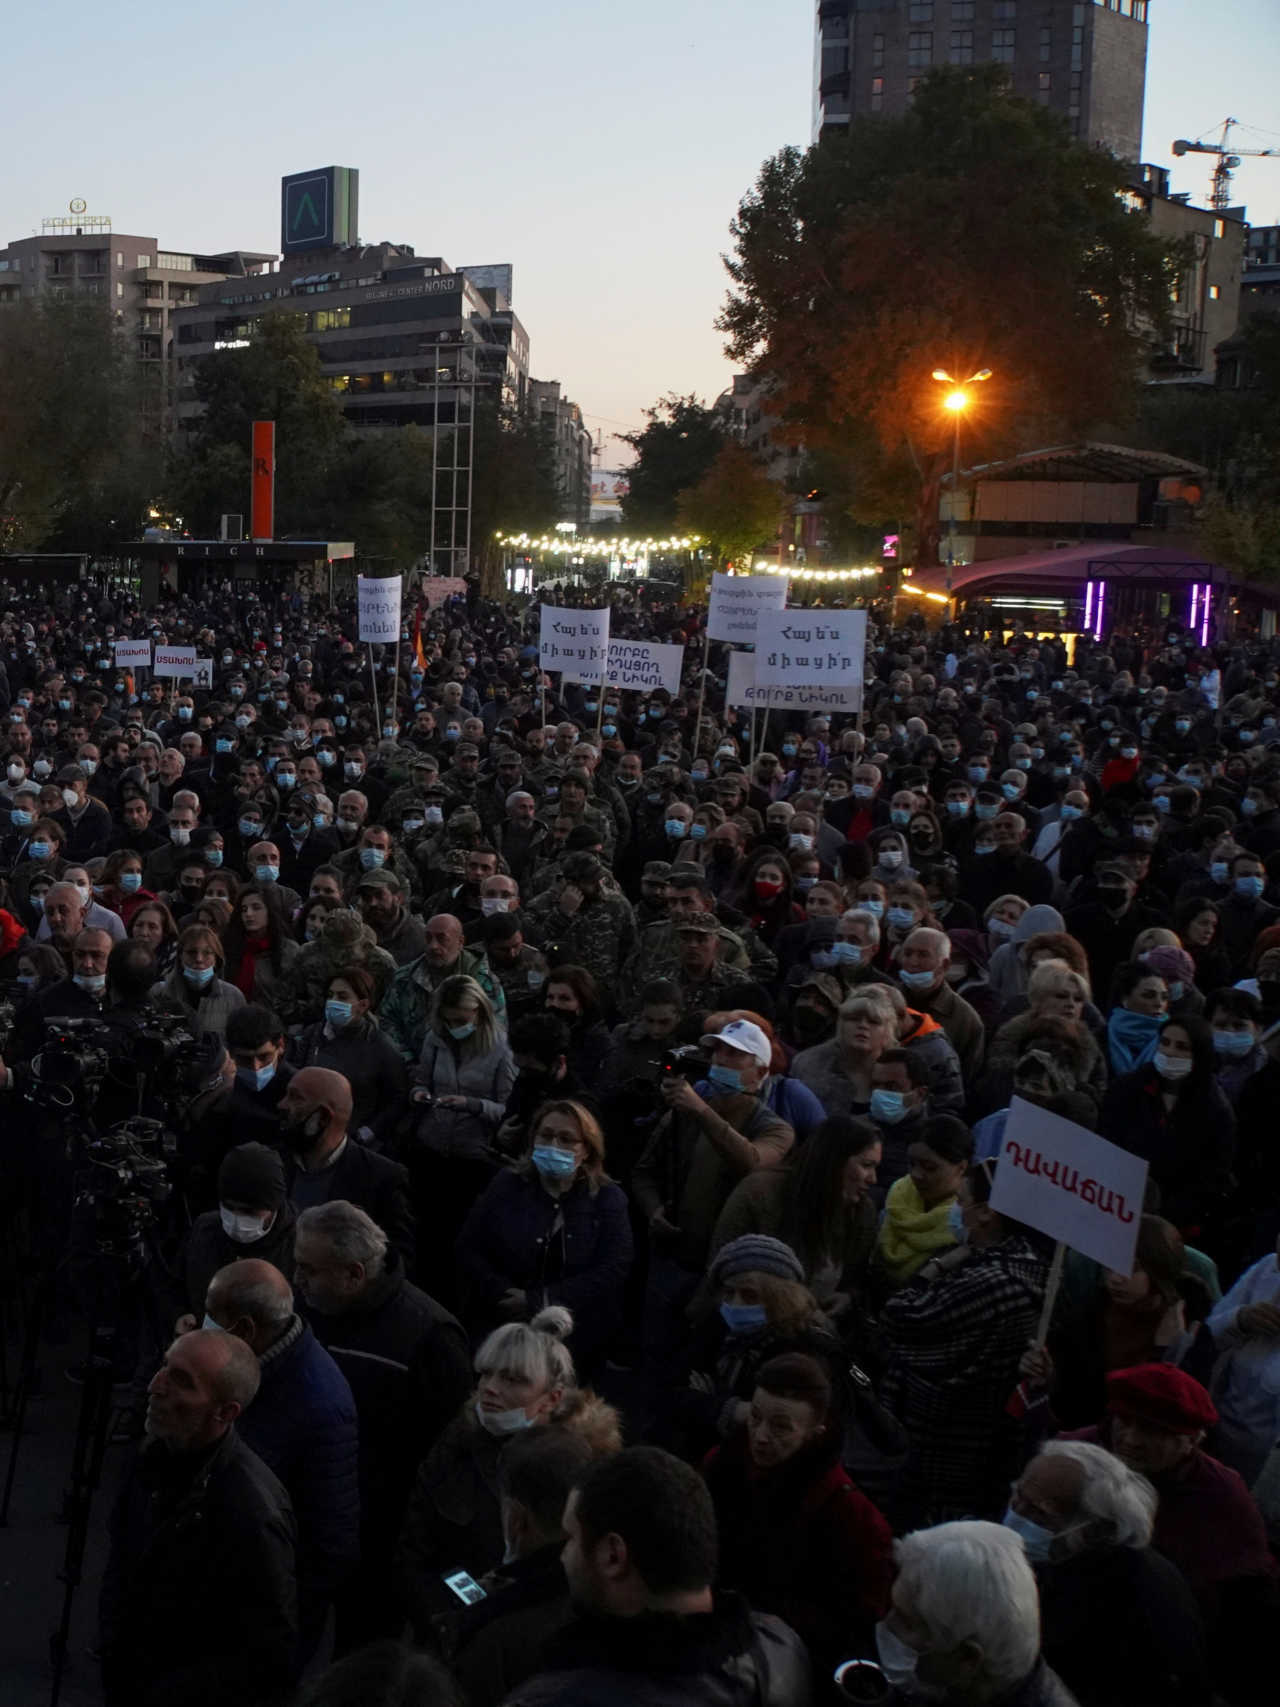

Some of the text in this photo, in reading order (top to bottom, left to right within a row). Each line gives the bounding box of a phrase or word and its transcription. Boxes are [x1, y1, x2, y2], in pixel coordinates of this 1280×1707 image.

[424, 279, 455, 293] NORD
[177, 546, 265, 556] RICH
[552, 621, 577, 637] Հայ
[780, 626, 812, 643] Հայ
[607, 644, 650, 660] ՈՒՐԲԸ
[622, 672, 665, 687] ՆԻԿՈԼ
[797, 692, 849, 705] ՆԻԿՈԼ
[1005, 1140, 1135, 1224] ԴԱՎԱՃԱՆ
